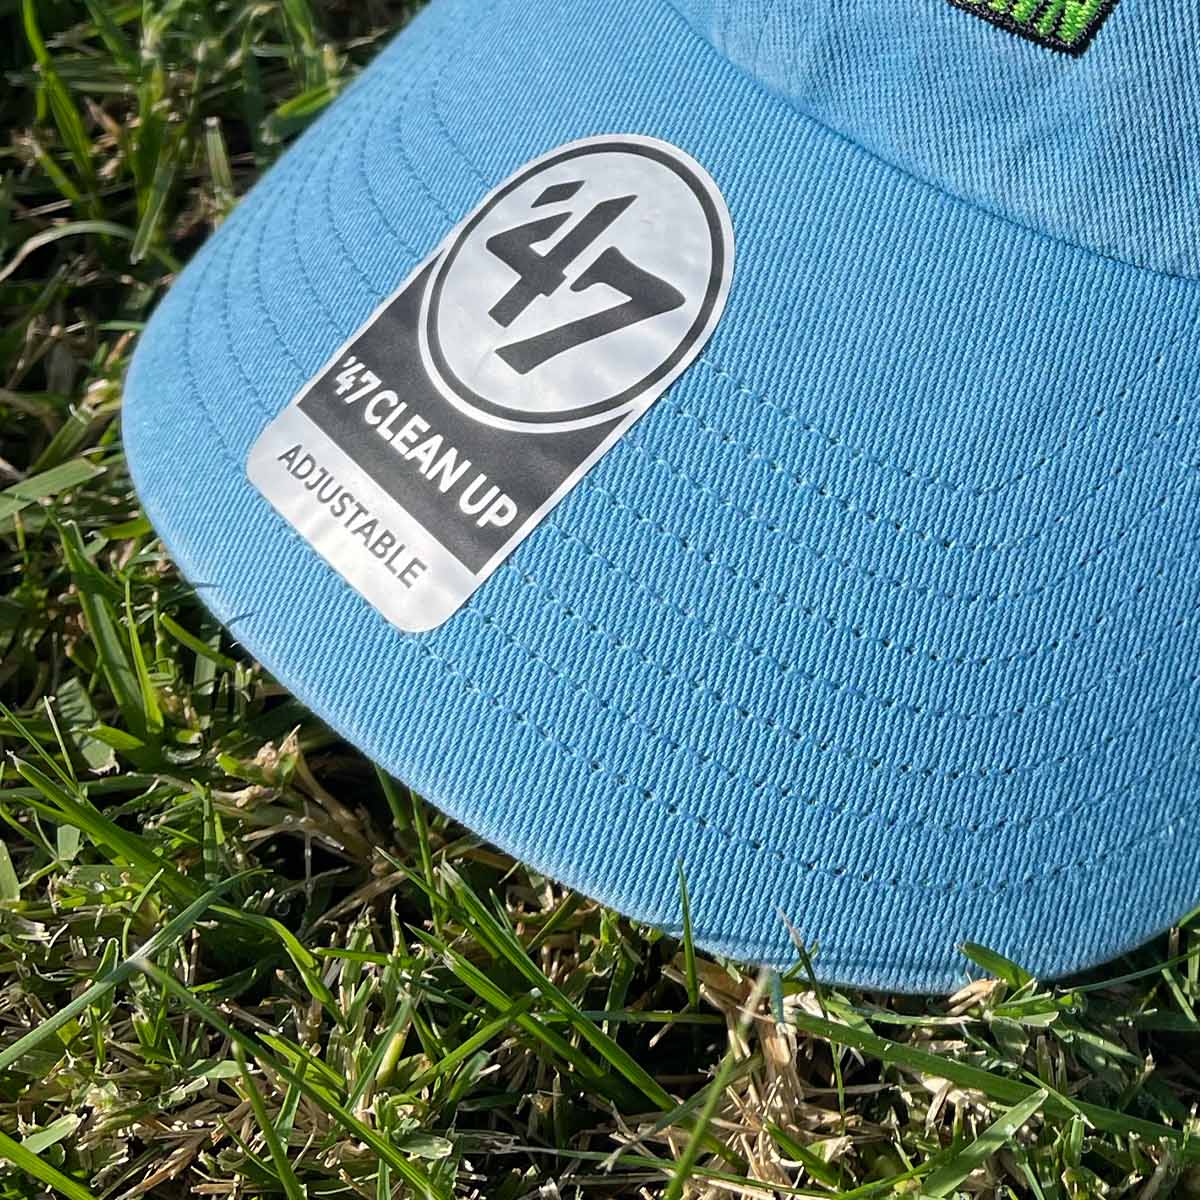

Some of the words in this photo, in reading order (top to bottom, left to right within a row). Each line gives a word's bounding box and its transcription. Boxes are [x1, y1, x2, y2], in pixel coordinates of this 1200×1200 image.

[277, 443, 428, 590] ADJUSTABLE
[364, 389, 471, 493] CLEAN
[458, 473, 519, 530] UP
